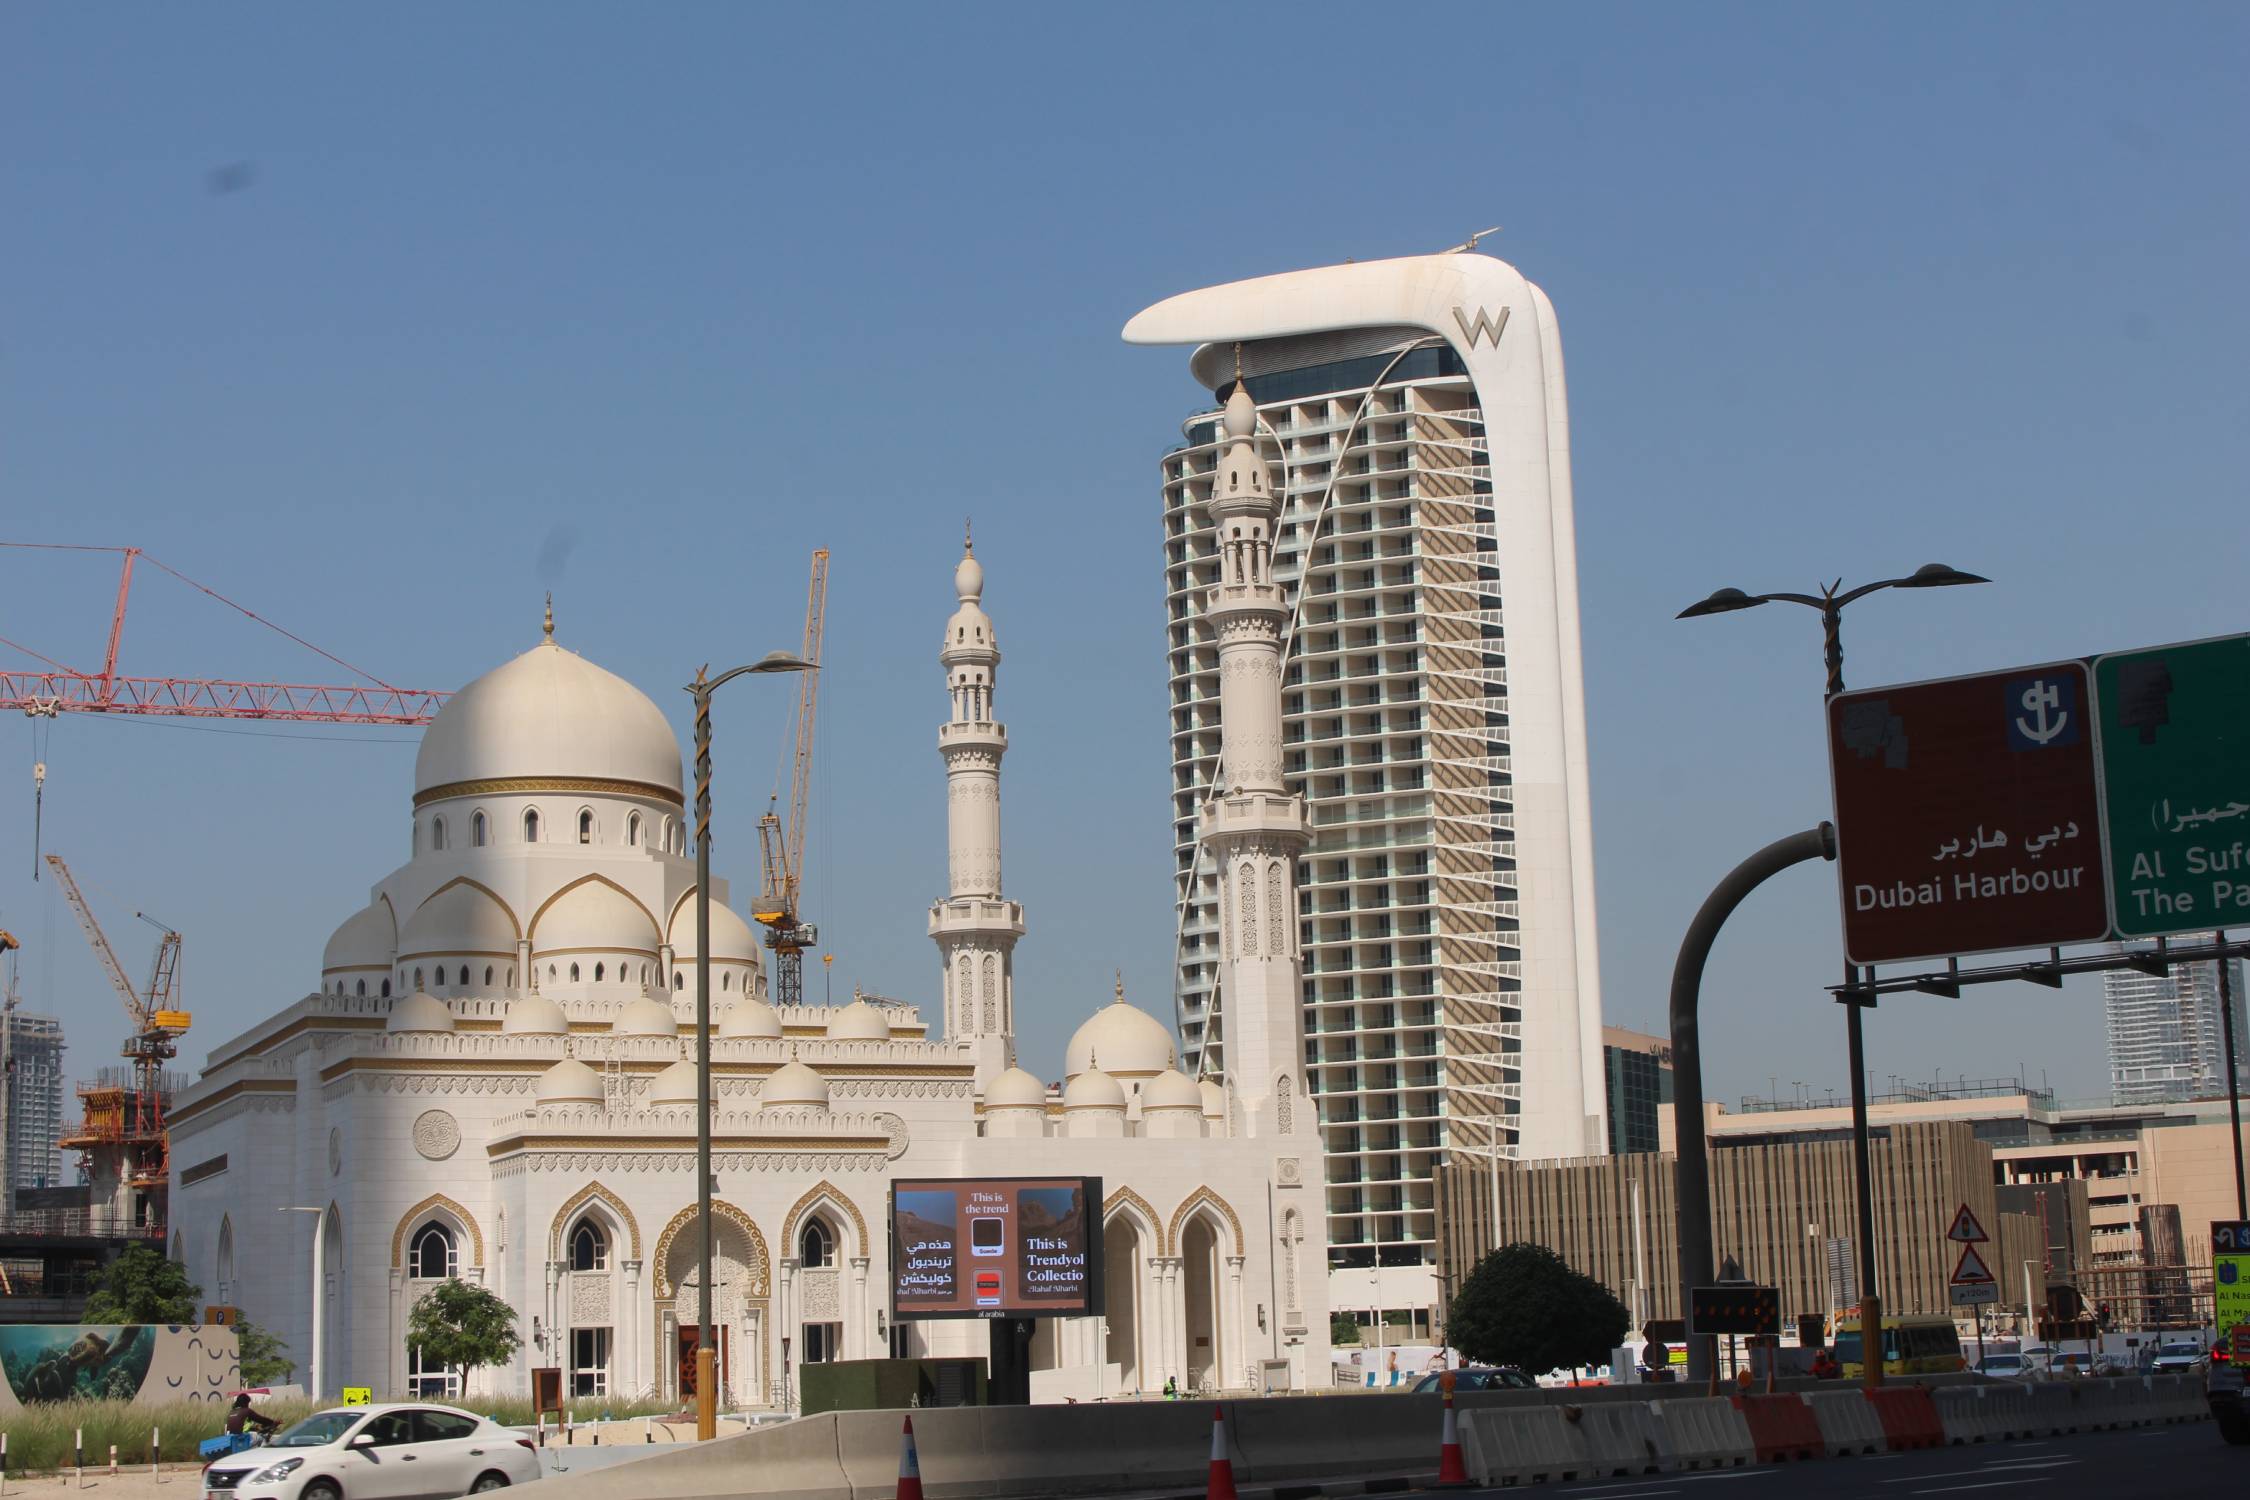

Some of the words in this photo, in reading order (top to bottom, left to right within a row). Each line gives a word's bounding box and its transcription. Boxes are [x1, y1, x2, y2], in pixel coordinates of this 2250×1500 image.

[1452, 305, 1511, 351] W
[1931, 823, 2008, 861] هاربر
[2025, 821, 2080, 860] دبي
[2130, 850, 2167, 881] Al
[1854, 875, 1943, 911] Dubai
[1954, 865, 2084, 901] Harbour
[2130, 887, 2195, 917] The
[970, 1192, 993, 1202] This
[995, 1192, 1003, 1202] is
[965, 1204, 981, 1214] the
[982, 1203, 1009, 1213] trend
[906, 1241, 927, 1255] هي
[928, 1240, 952, 1250] هذه
[1026, 1238, 1055, 1250] This
[1057, 1238, 1068, 1249] is
[907, 1256, 953, 1270] ترينديول
[1026, 1253, 1084, 1268] Trendyol
[900, 1272, 952, 1286] كوليكشن
[1027, 1269, 1084, 1282] Collectio
